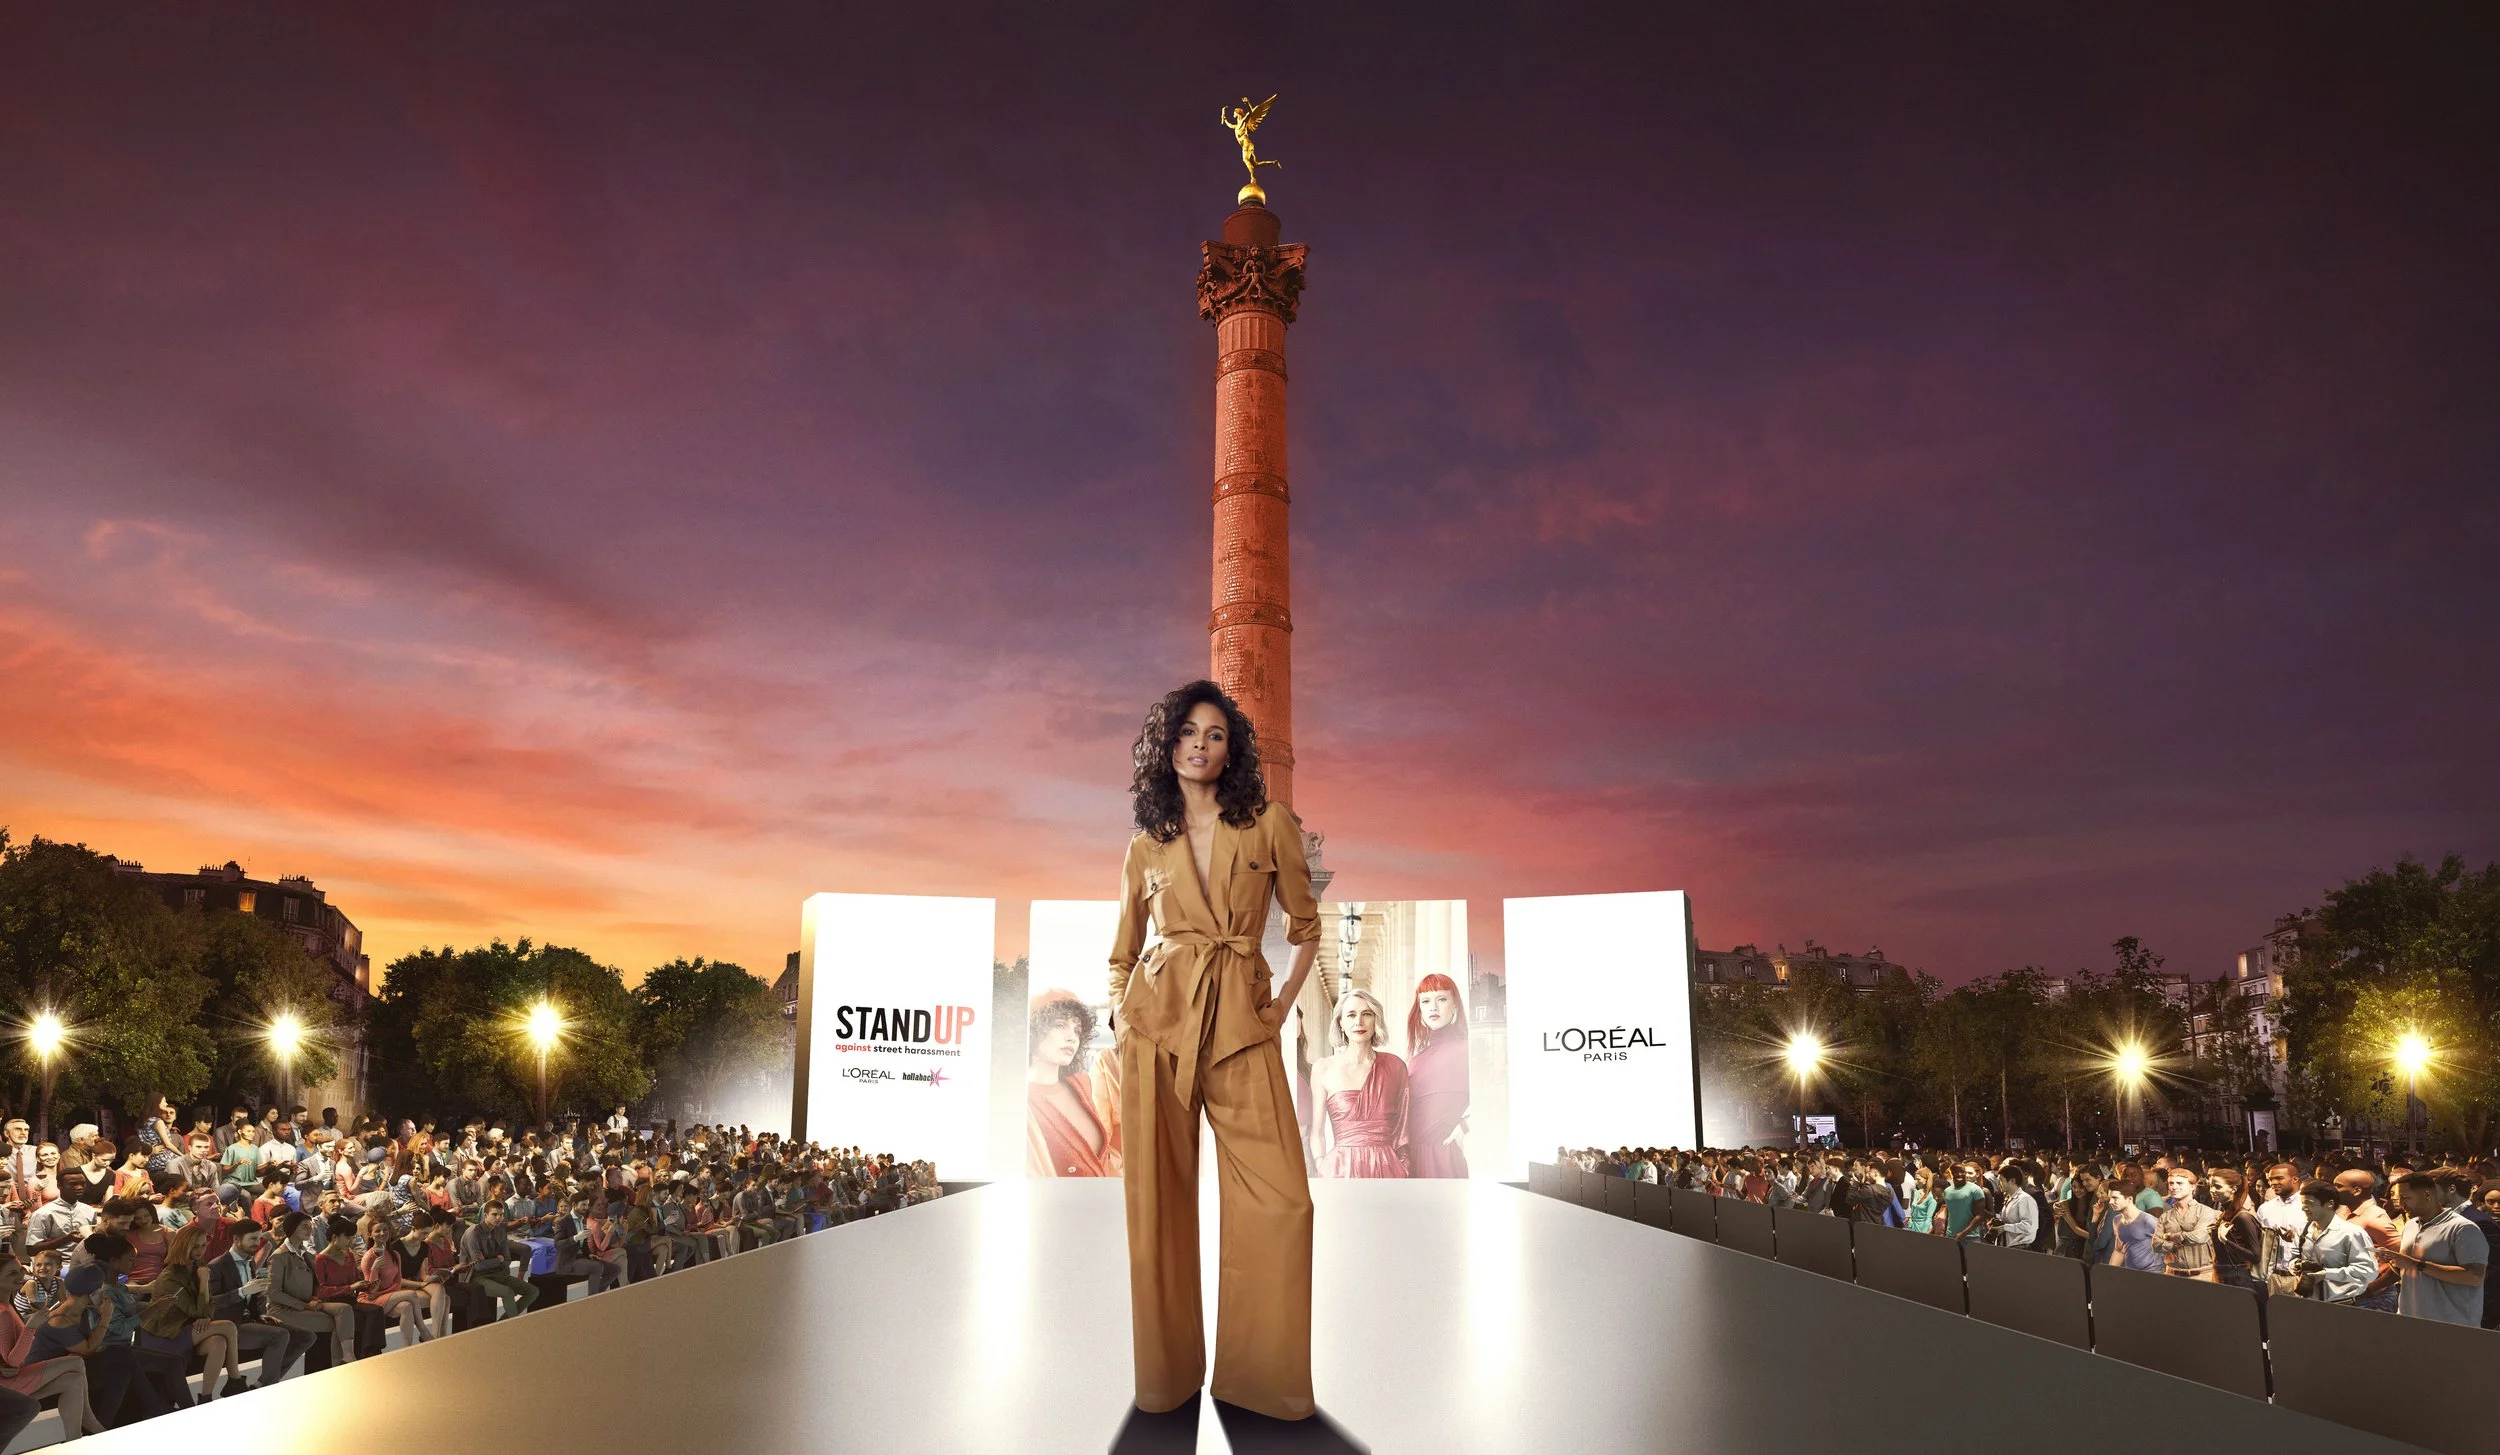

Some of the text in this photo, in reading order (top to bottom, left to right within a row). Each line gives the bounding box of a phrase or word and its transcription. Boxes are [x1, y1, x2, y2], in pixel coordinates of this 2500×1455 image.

[1543, 1026, 1667, 1052] L'ORÉAL
[835, 1043, 961, 1057] against street harassment
[842, 1067, 896, 1080] L'ORÉAL
